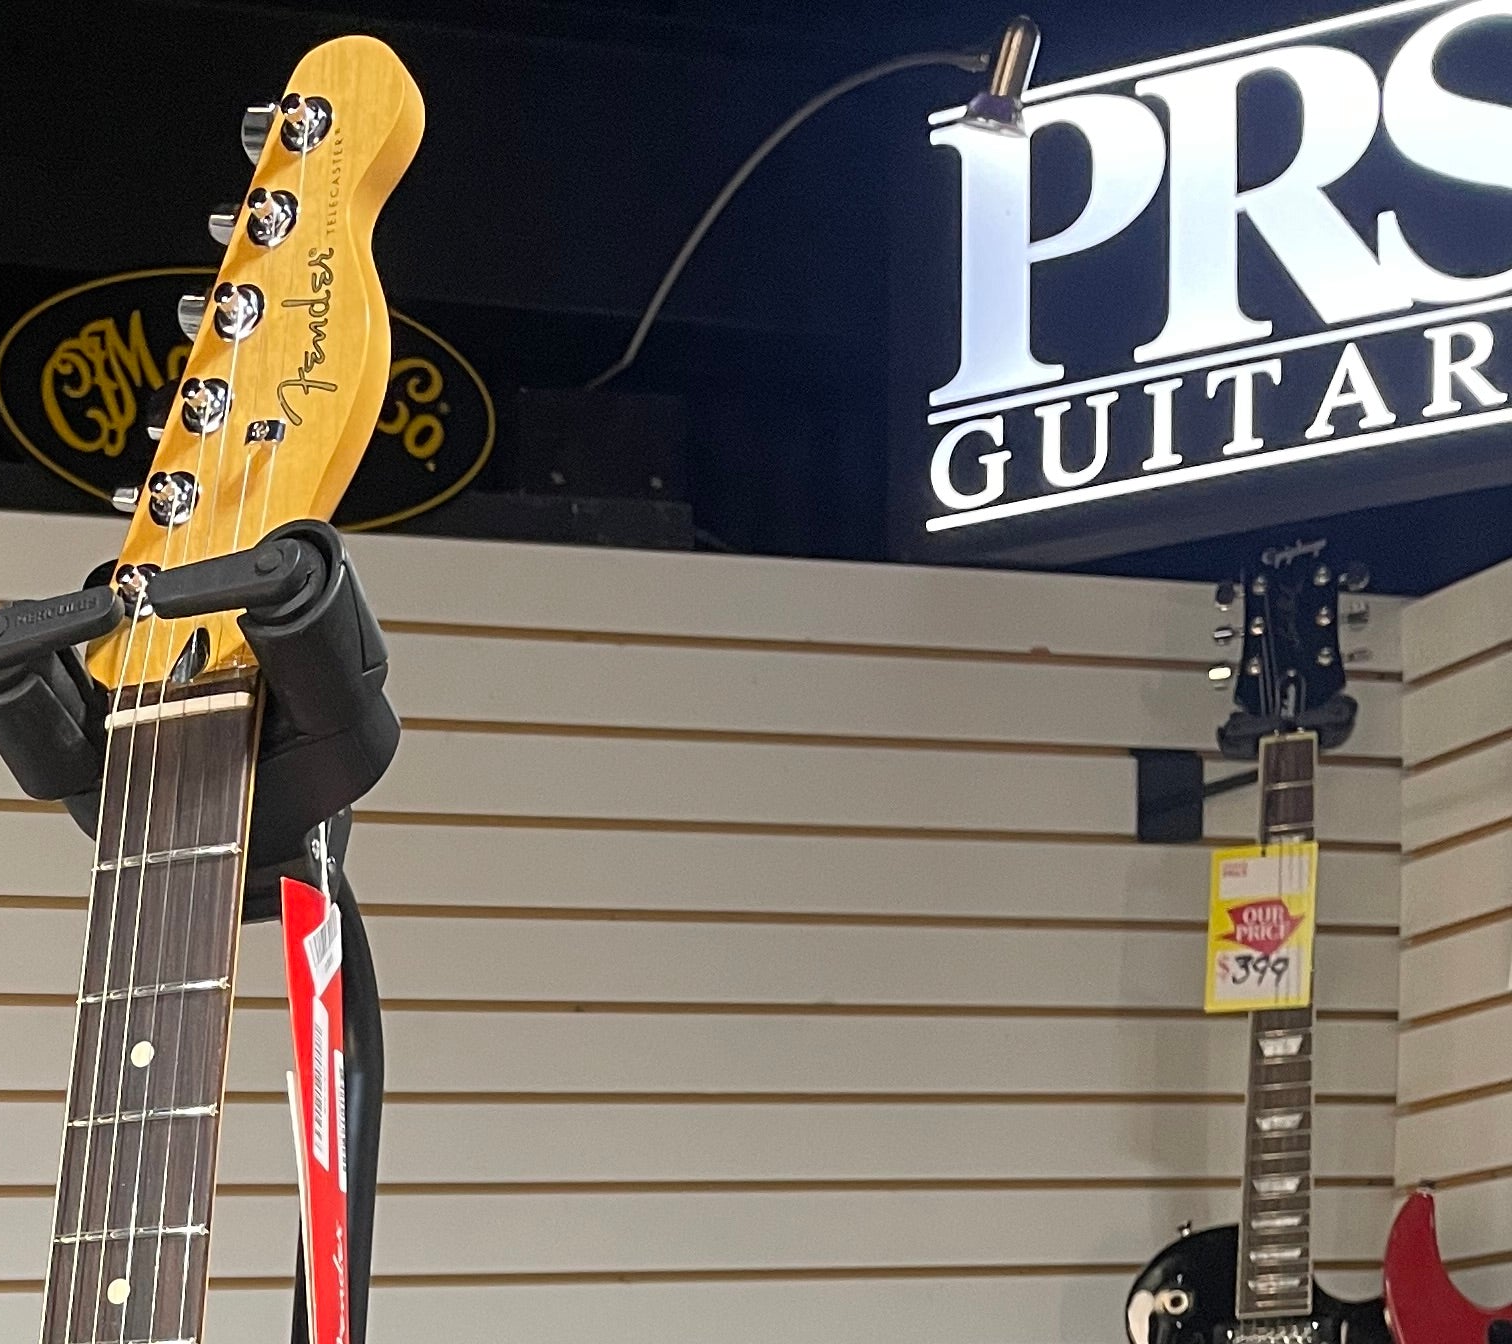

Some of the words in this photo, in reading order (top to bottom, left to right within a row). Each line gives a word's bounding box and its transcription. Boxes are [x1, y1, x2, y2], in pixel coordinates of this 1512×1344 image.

[929, 0, 1512, 407] PRS
[1242, 905, 1284, 925] OUR
[1235, 923, 1289, 941] PRICE
